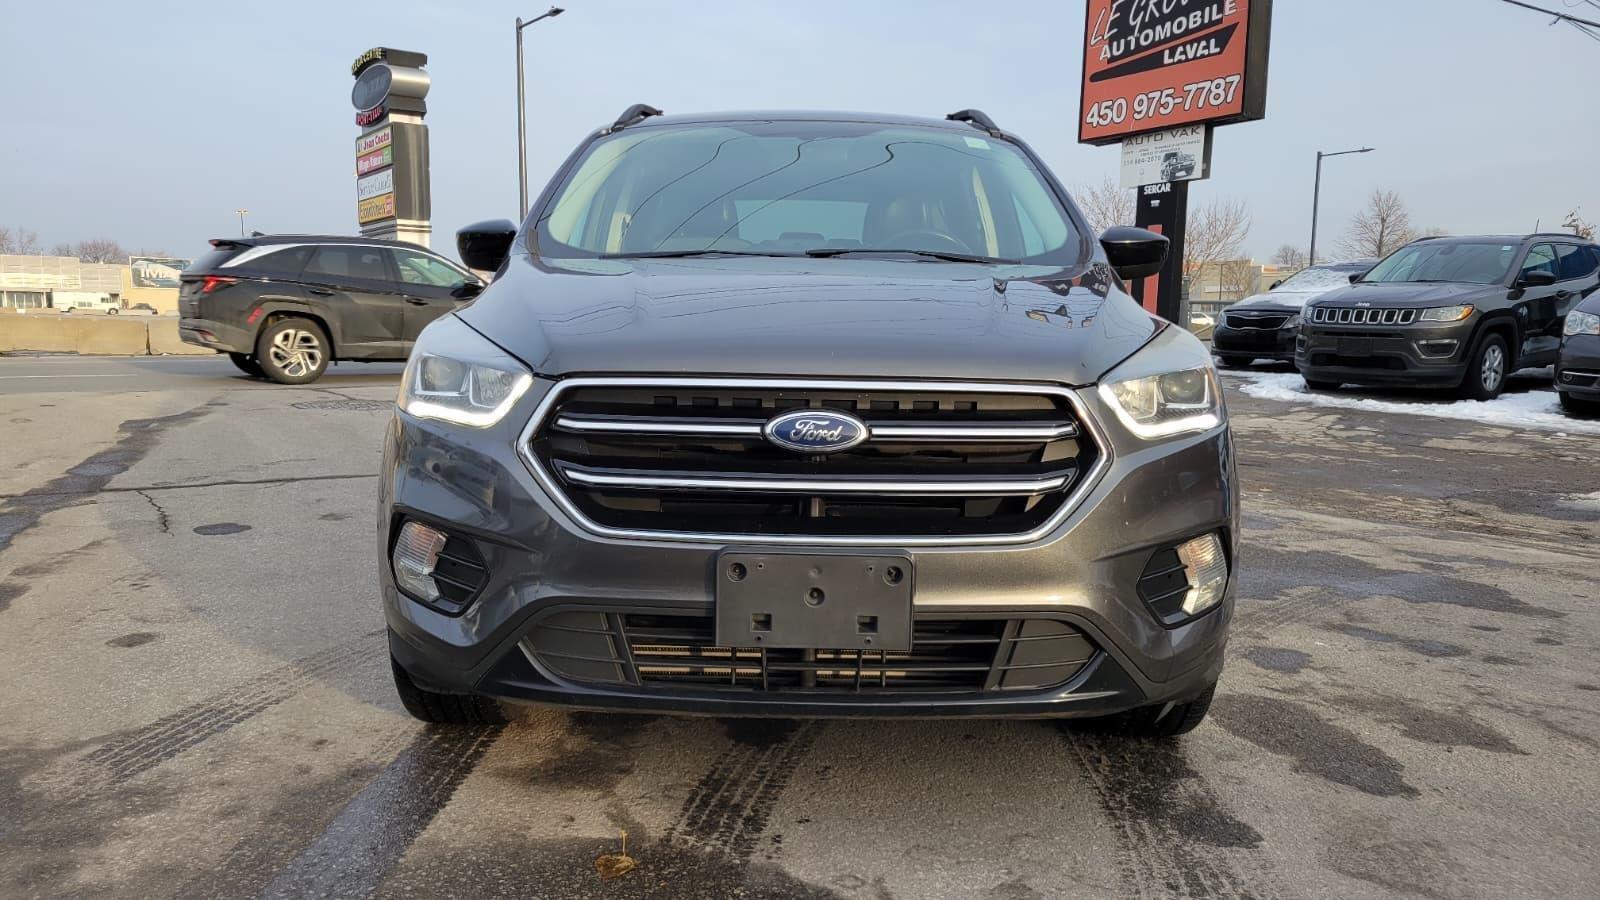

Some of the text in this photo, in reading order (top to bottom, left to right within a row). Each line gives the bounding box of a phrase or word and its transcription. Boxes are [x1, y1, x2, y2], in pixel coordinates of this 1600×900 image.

[1090, 0, 1121, 46] LE
[1099, 0, 1238, 61] AUTOMOBILE
[1164, 39, 1220, 64] LAVAL
[1086, 74, 1241, 128] 450 975-7787
[1125, 133, 1164, 146] AUTO
[1170, 127, 1201, 138] VAK
[1143, 183, 1171, 195] SERCAR
[790, 419, 843, 441] Ford
